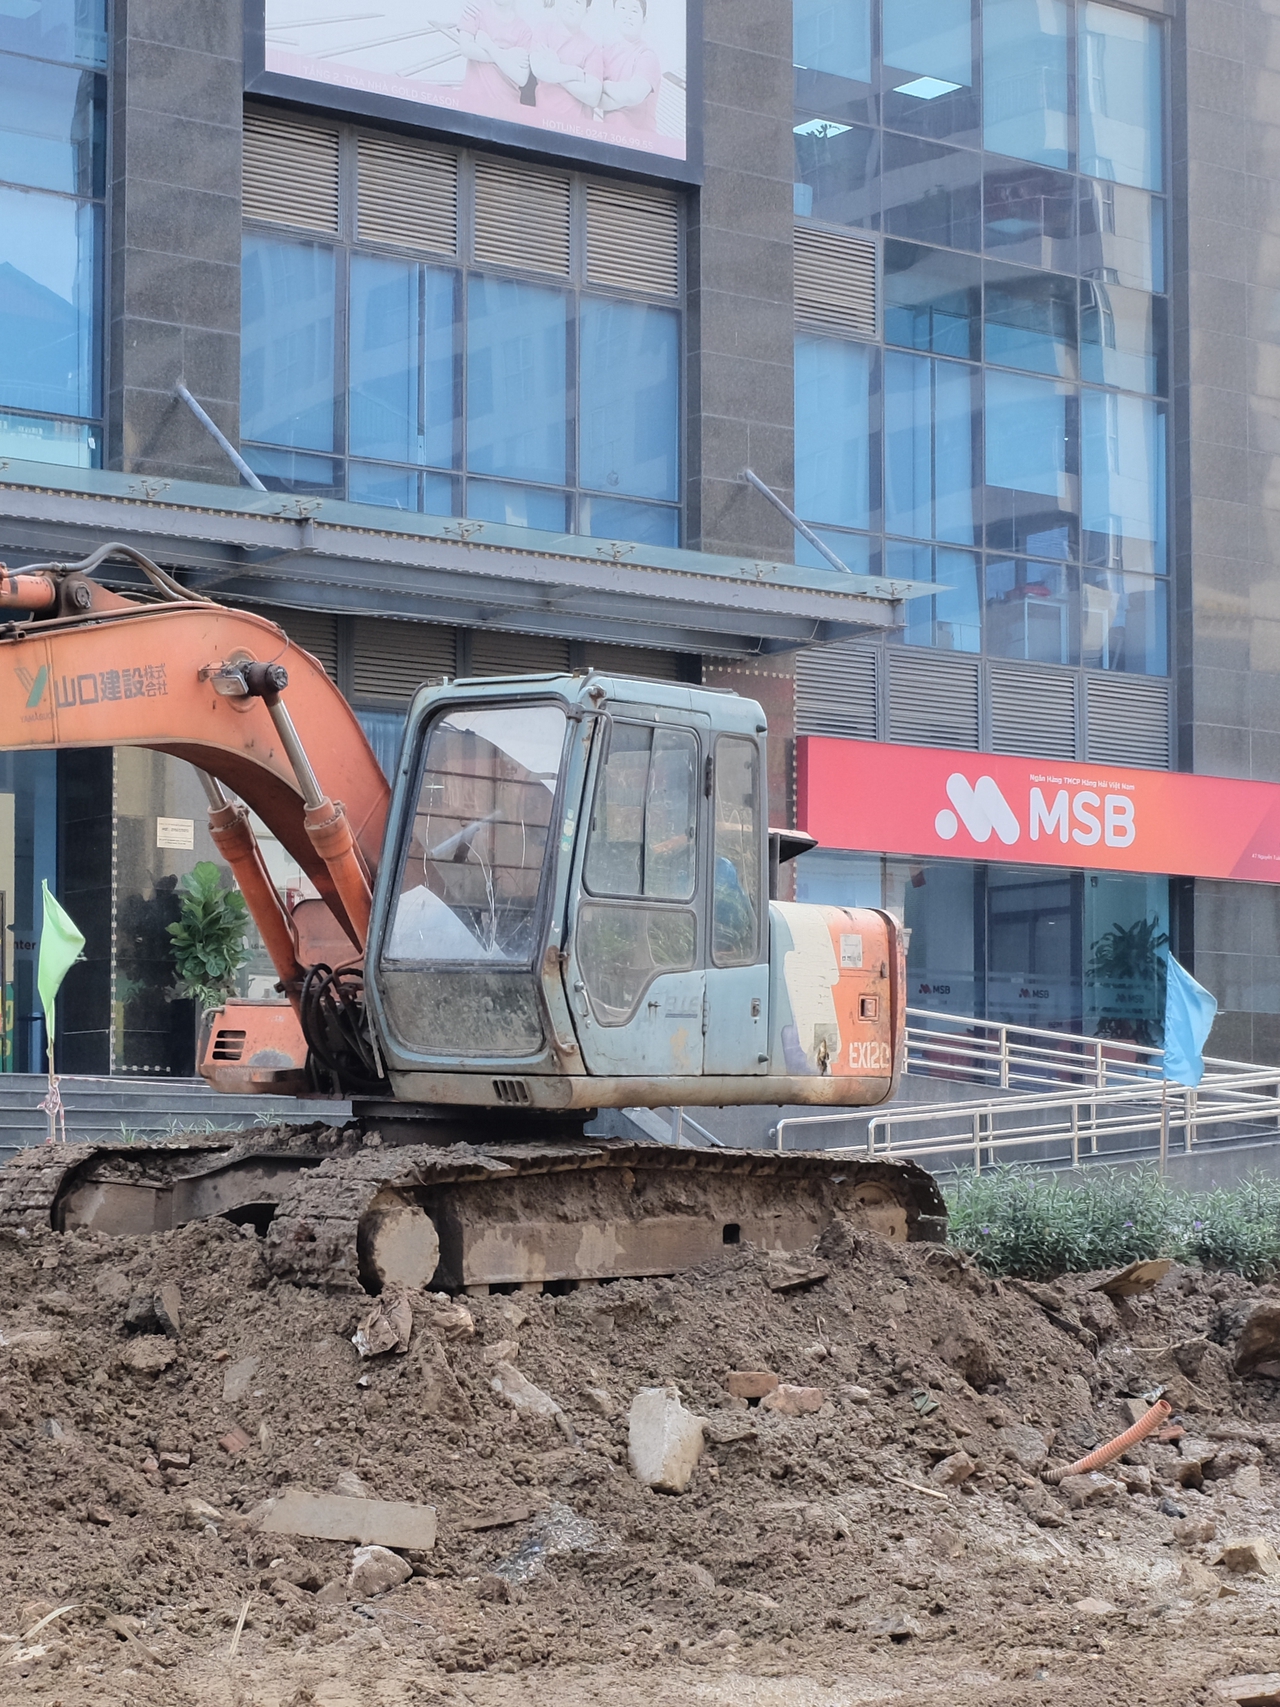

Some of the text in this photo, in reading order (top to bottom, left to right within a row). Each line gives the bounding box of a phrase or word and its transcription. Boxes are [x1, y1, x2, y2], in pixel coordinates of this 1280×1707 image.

[367, 79, 387, 92] NHÀ
[391, 85, 418, 98] GOLD
[421, 91, 460, 108] SEASON
[543, 119, 583, 134] HOTLINE:
[1030, 787, 1136, 848] MSB
[932, 984, 951, 995] MSB
[1032, 989, 1050, 999] MSB
